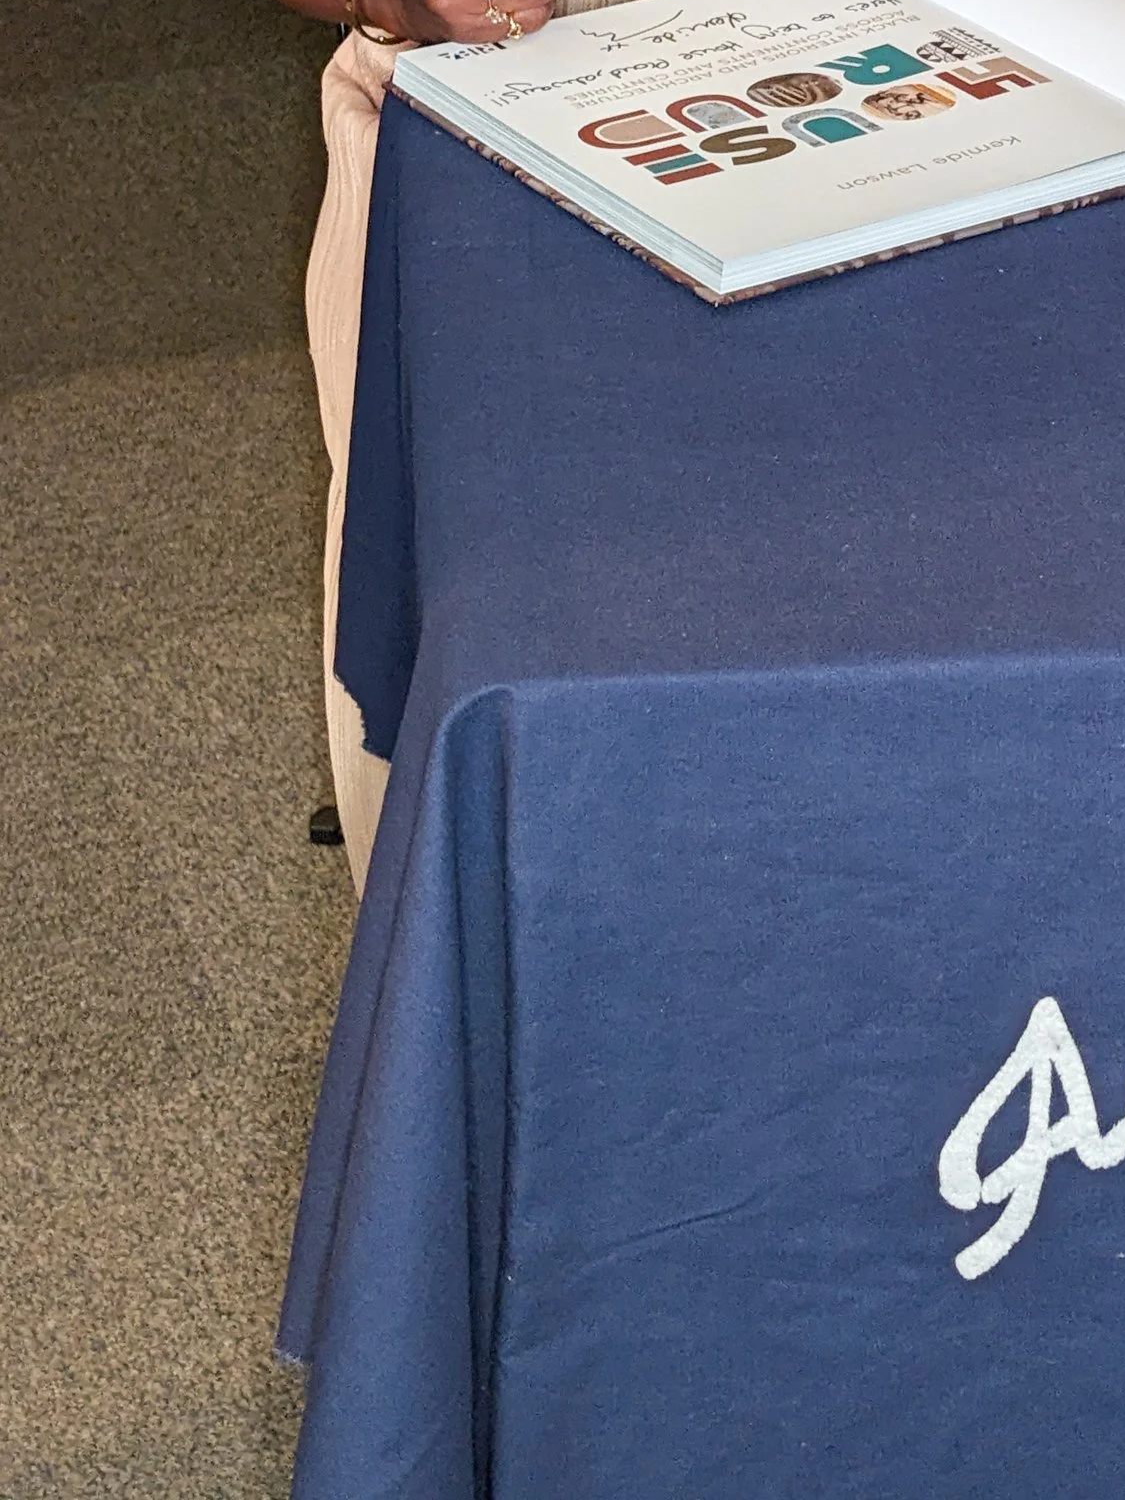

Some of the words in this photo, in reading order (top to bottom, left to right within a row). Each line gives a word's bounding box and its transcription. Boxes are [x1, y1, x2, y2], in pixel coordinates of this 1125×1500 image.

[843, 9, 905, 32] ACROSS
[858, 14, 921, 36] BLACK
[716, 30, 834, 65] CONTINENTS
[762, 29, 859, 64] INTERIORS
[563, 73, 672, 102] CENTURIES
[573, 70, 713, 110] ARCHITECTURE
[933, 135, 1022, 167] Kemide
[836, 160, 927, 192] Lawson
